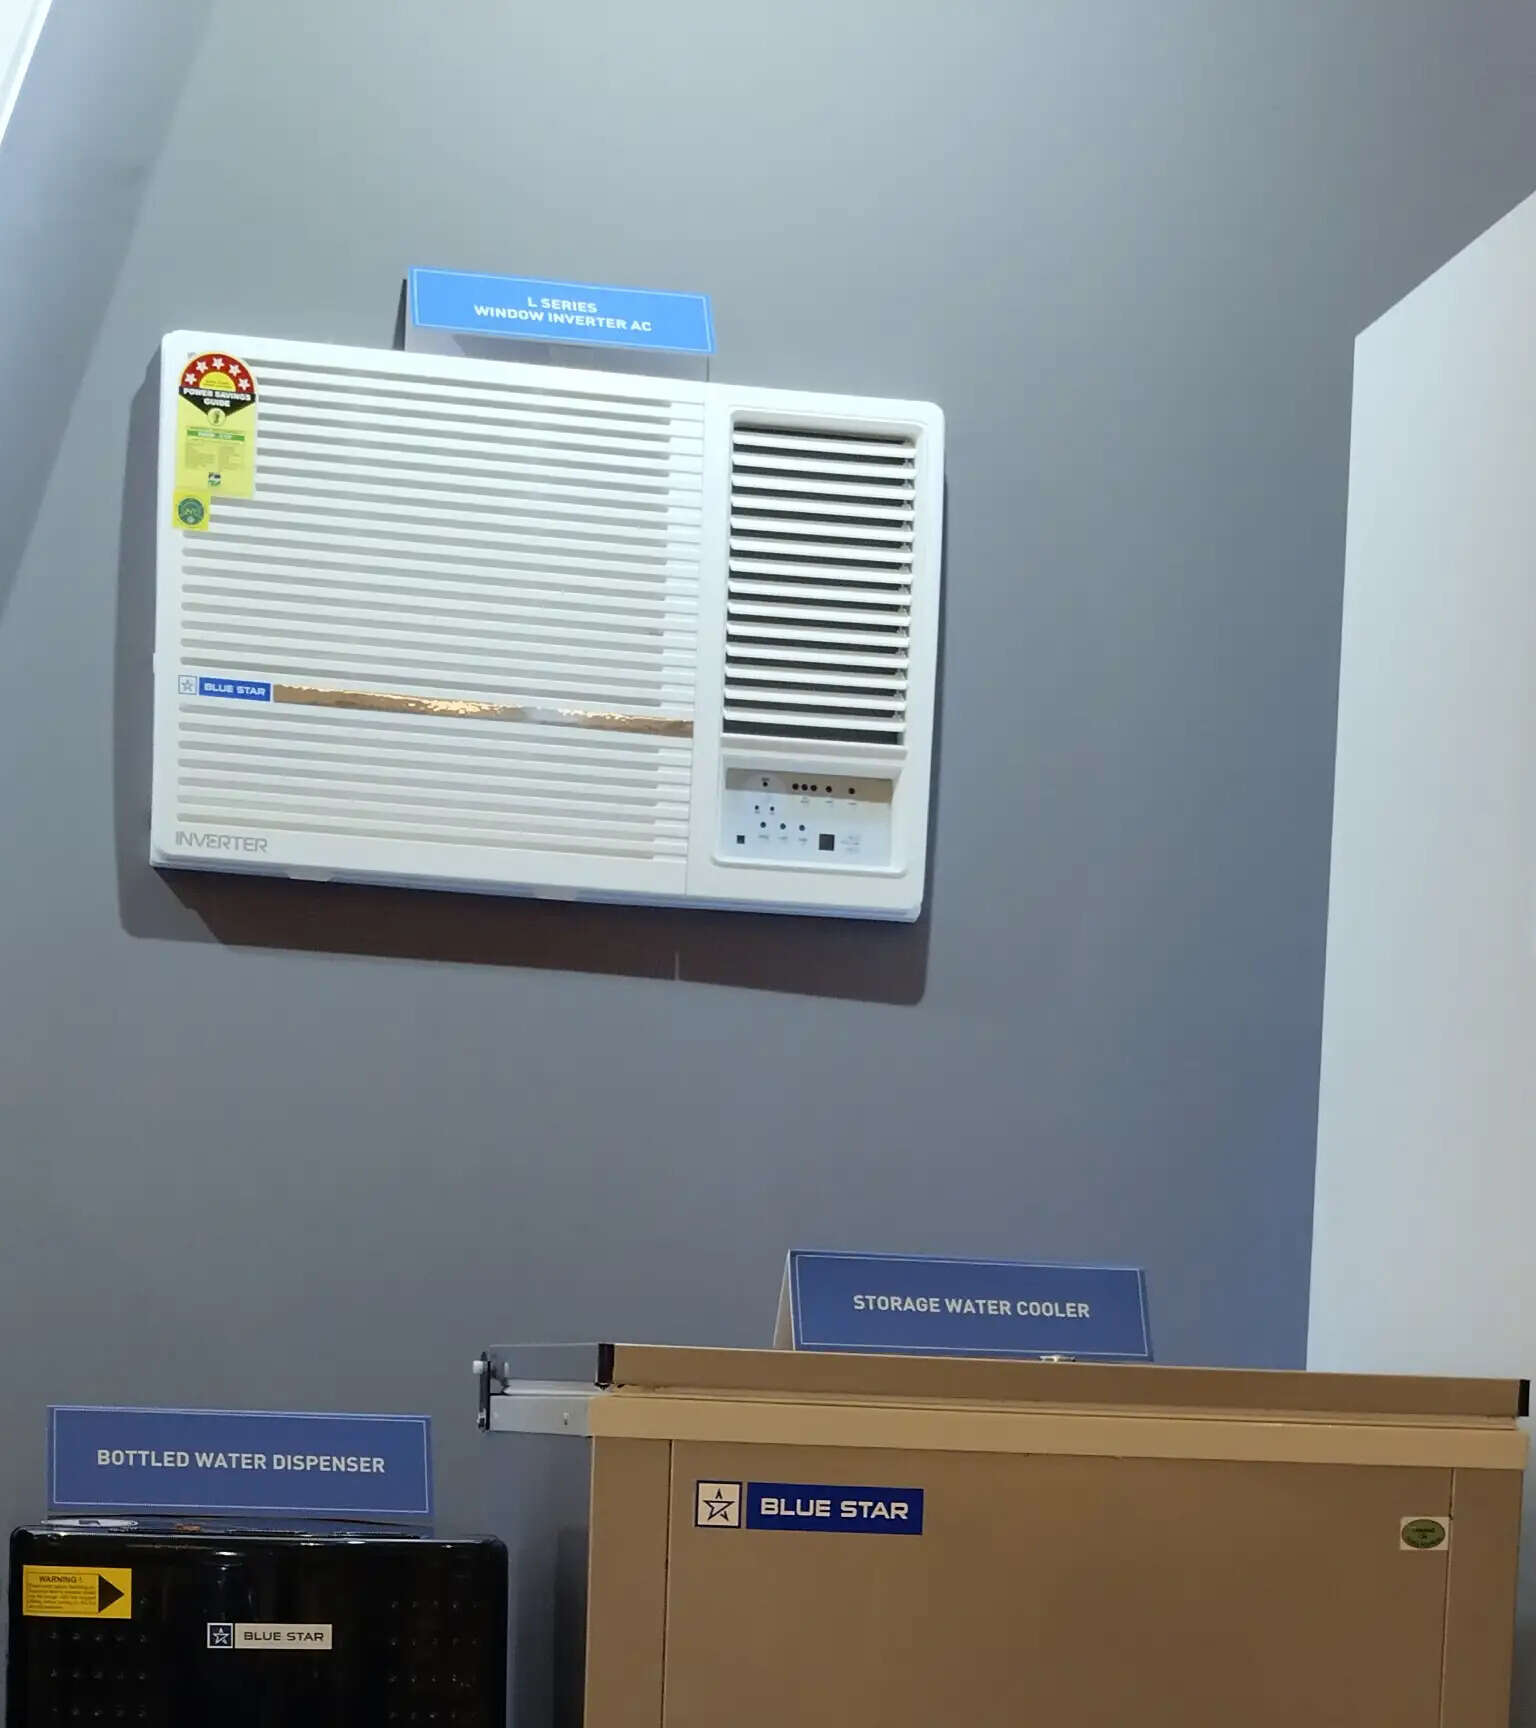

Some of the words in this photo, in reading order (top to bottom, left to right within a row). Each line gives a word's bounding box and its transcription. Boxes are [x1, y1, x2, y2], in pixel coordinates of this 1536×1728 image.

[527, 297, 537, 307] L
[541, 298, 597, 314] SERIES
[473, 304, 544, 322] WINDOW
[548, 312, 627, 330] INVERTER
[630, 320, 652, 332] AC
[183, 387, 213, 398] POWER
[204, 398, 230, 408] GUIDE
[204, 682, 233, 693] BLUE
[237, 685, 266, 696] STAR
[175, 830, 268, 853] INVERTER
[853, 1294, 941, 1313] STORAGE
[944, 1298, 1012, 1315] WATER
[1016, 1300, 1090, 1318] COOLER
[97, 1449, 189, 1468] BOTTLED
[195, 1451, 266, 1470] WATER
[272, 1454, 385, 1473] DISPENSER
[760, 1497, 831, 1517] BLUE
[840, 1500, 909, 1520] STAR
[39, 1575, 77, 1583] WARNING
[244, 1631, 281, 1642] BLUE
[287, 1632, 324, 1642] STAR
